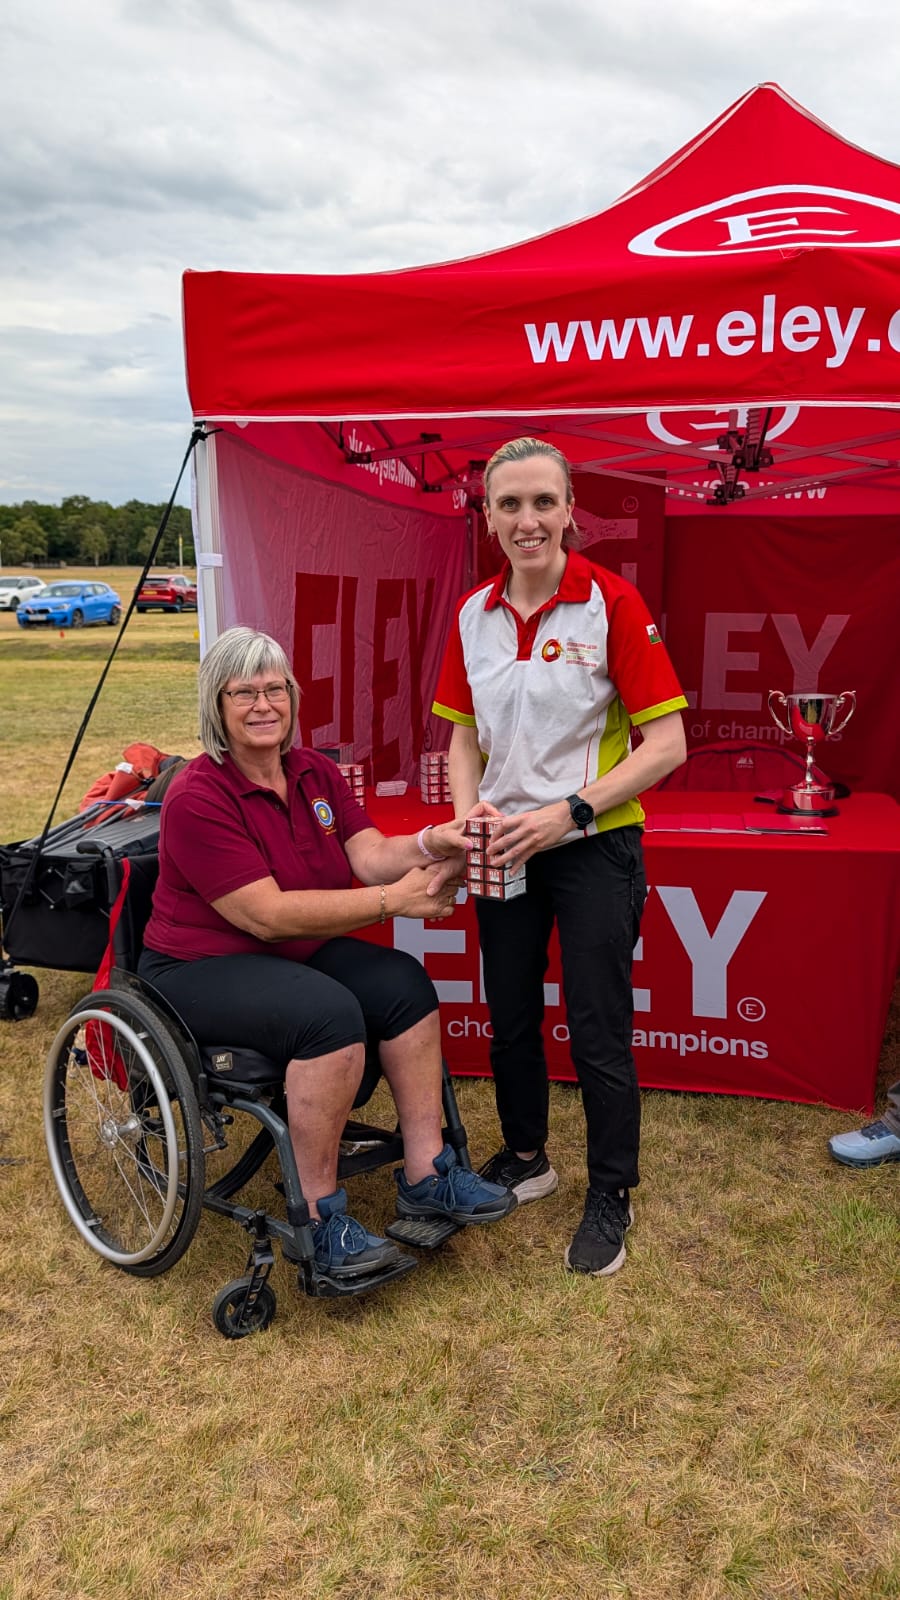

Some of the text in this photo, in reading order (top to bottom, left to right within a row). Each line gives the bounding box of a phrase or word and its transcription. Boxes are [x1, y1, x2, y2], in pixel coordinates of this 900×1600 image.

[714, 206, 858, 247] E
[690, 720, 843, 746] of champs
[446, 1015, 769, 1060] cho o ampions
